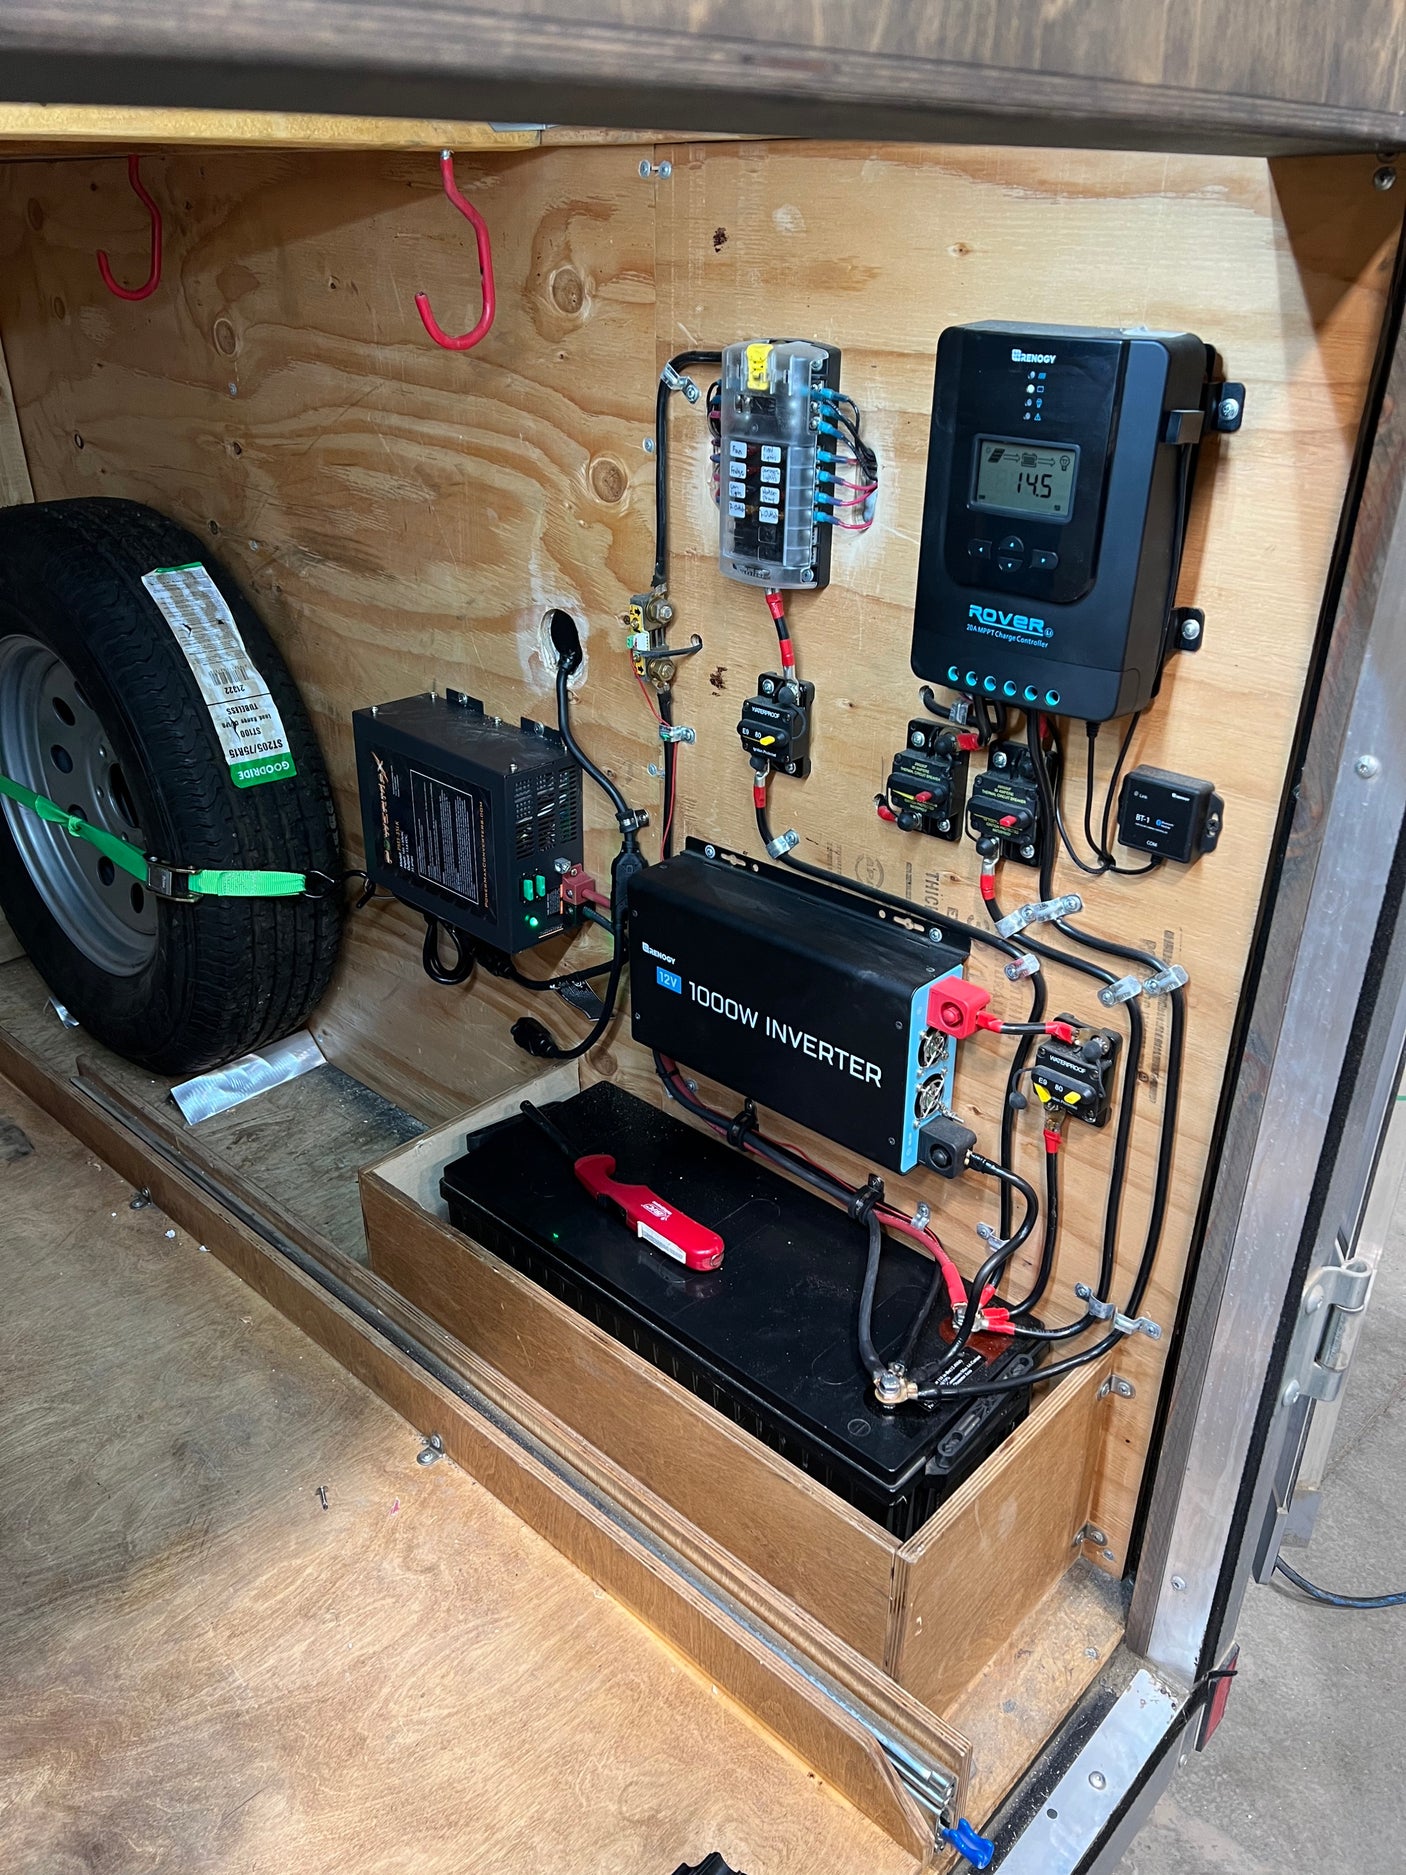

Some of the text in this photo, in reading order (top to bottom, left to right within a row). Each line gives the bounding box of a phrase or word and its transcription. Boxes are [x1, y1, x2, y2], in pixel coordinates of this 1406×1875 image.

[1020, 352, 1056, 364] RENOGY
[1017, 472, 1052, 498] 14.5
[977, 626, 995, 636] MPPT
[995, 630, 1016, 642] Charge
[1016, 635, 1048, 648] Controller
[224, 684, 245, 695] 21322
[225, 702, 259, 715] TUBELESS
[751, 706, 780, 719] WATERPROOF
[240, 716, 257, 724] Range
[259, 713, 272, 721] Load
[240, 726, 262, 738] ST100
[228, 738, 284, 759] ST205/75R15
[237, 761, 290, 780] GOODRIDE
[1135, 813, 1150, 824] BT-1
[648, 946, 676, 965] RENOGY
[659, 971, 677, 988] 12V
[688, 980, 883, 1088] 1000W INVERTER
[1049, 1055, 1086, 1074] WATERPROOF
